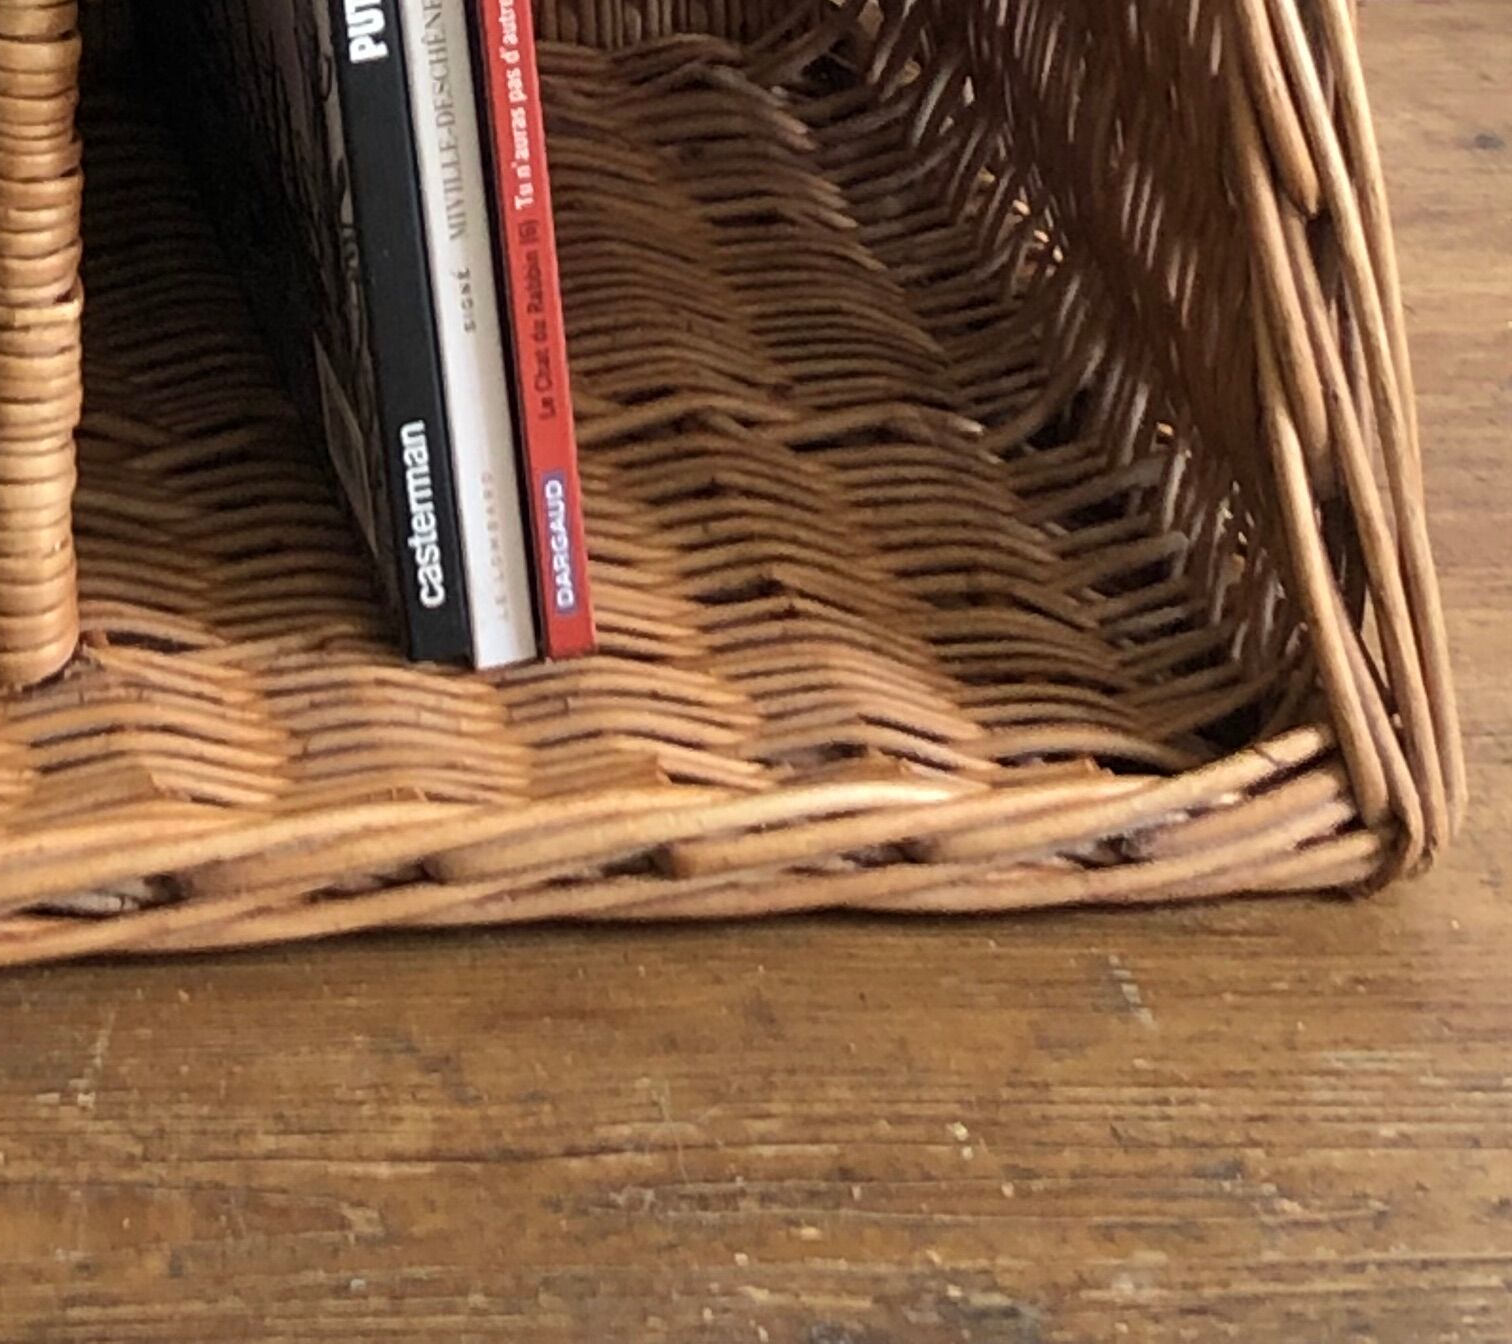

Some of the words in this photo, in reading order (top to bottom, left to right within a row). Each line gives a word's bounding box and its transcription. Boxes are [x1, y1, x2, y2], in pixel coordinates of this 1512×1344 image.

[506, 67, 527, 102] pas
[514, 181, 534, 211] Tu
[399, 420, 445, 608] casterman
[545, 479, 574, 608] DARGAUD
